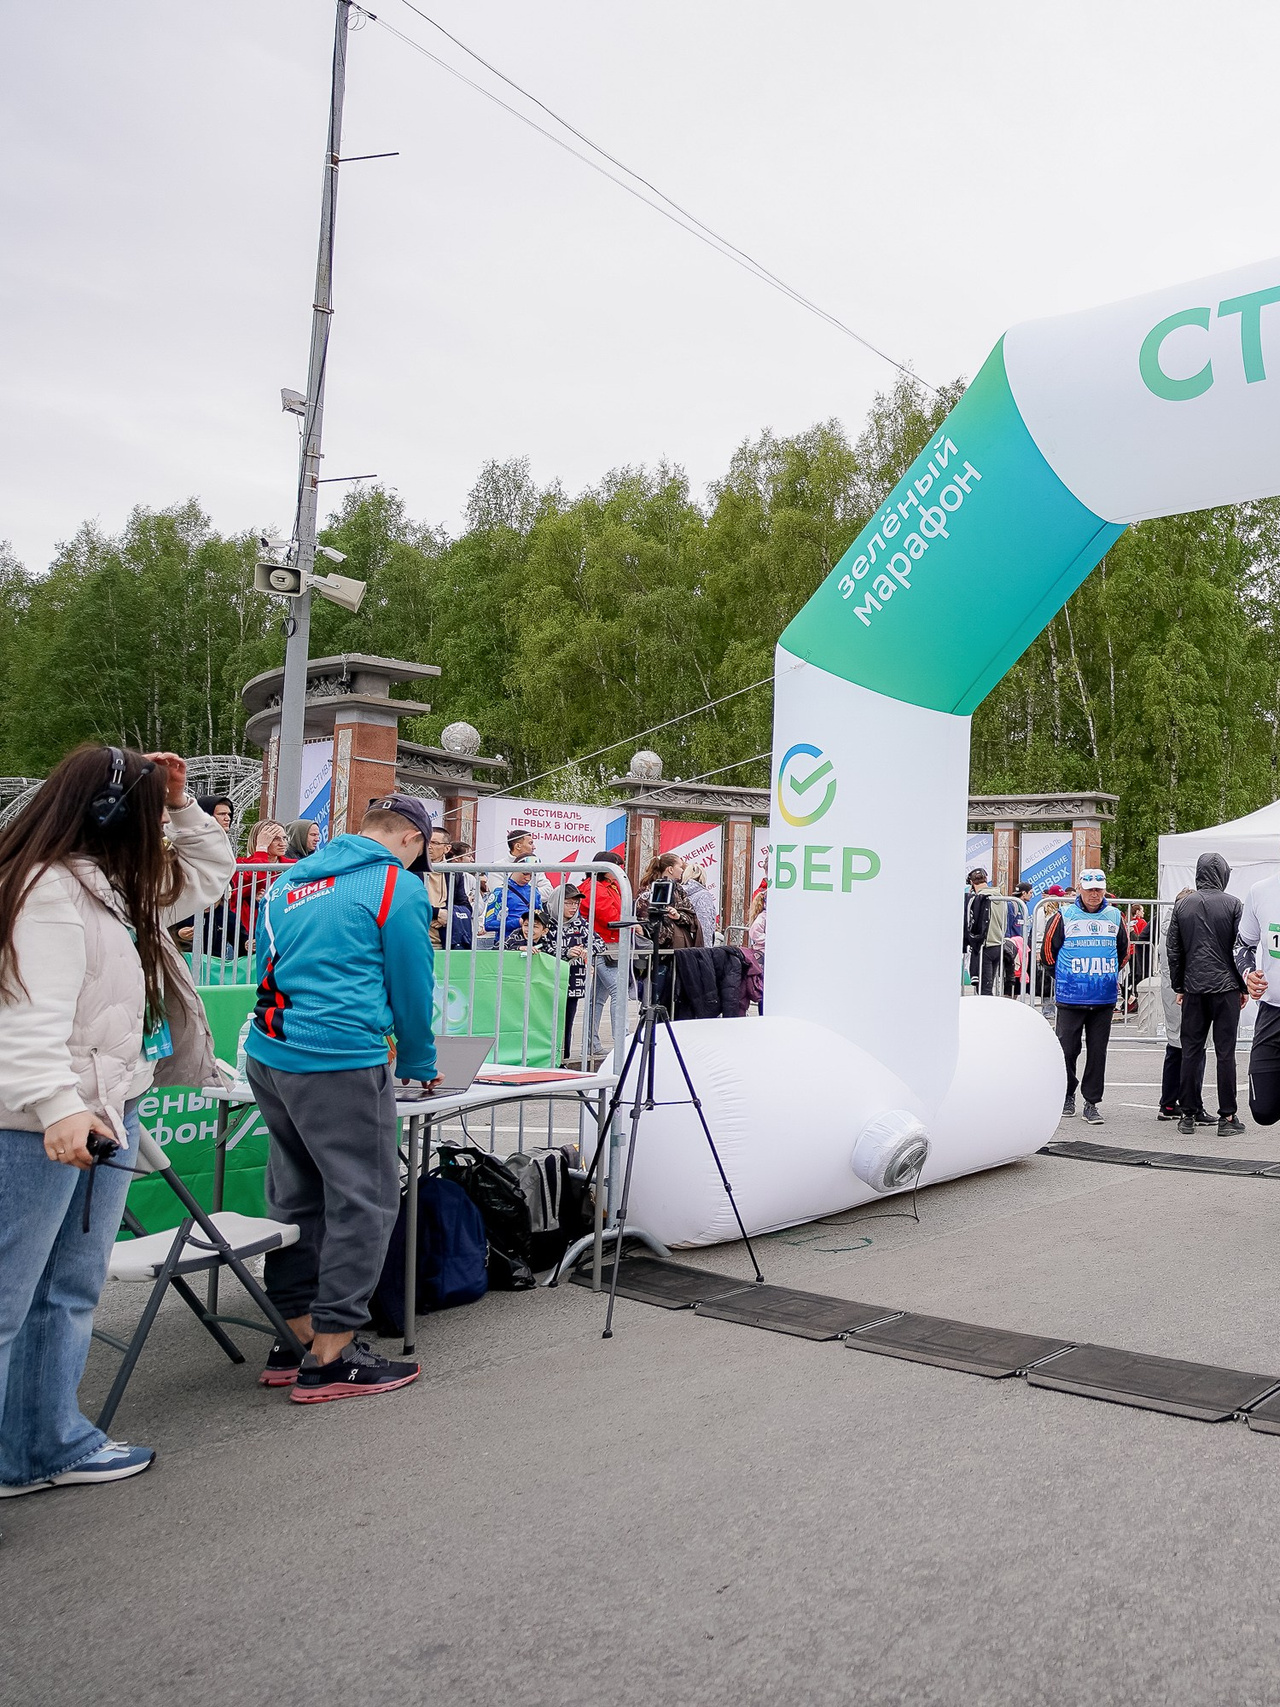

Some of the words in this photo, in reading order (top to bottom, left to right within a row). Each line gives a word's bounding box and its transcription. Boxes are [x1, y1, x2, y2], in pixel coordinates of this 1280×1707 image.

[837, 434, 959, 600] зелёный
[852, 460, 983, 627] марафон
[510, 817, 552, 829] ПЕРВЫХ
[523, 807, 582, 820] ФЕСТИВАЛЬ
[507, 829, 596, 844] Ы-МАНСИЙСК
[965, 838, 989, 855] МЕСТЕ
[1025, 838, 1062, 864] ФЕСТИВАЛЬ
[1027, 854, 1069, 885] ДВИЖЕНИЕ
[292, 879, 328, 900] TIME
[1031, 866, 1071, 899] ЕРВЫХ
[1071, 957, 1116, 976] СУДЬЯ
